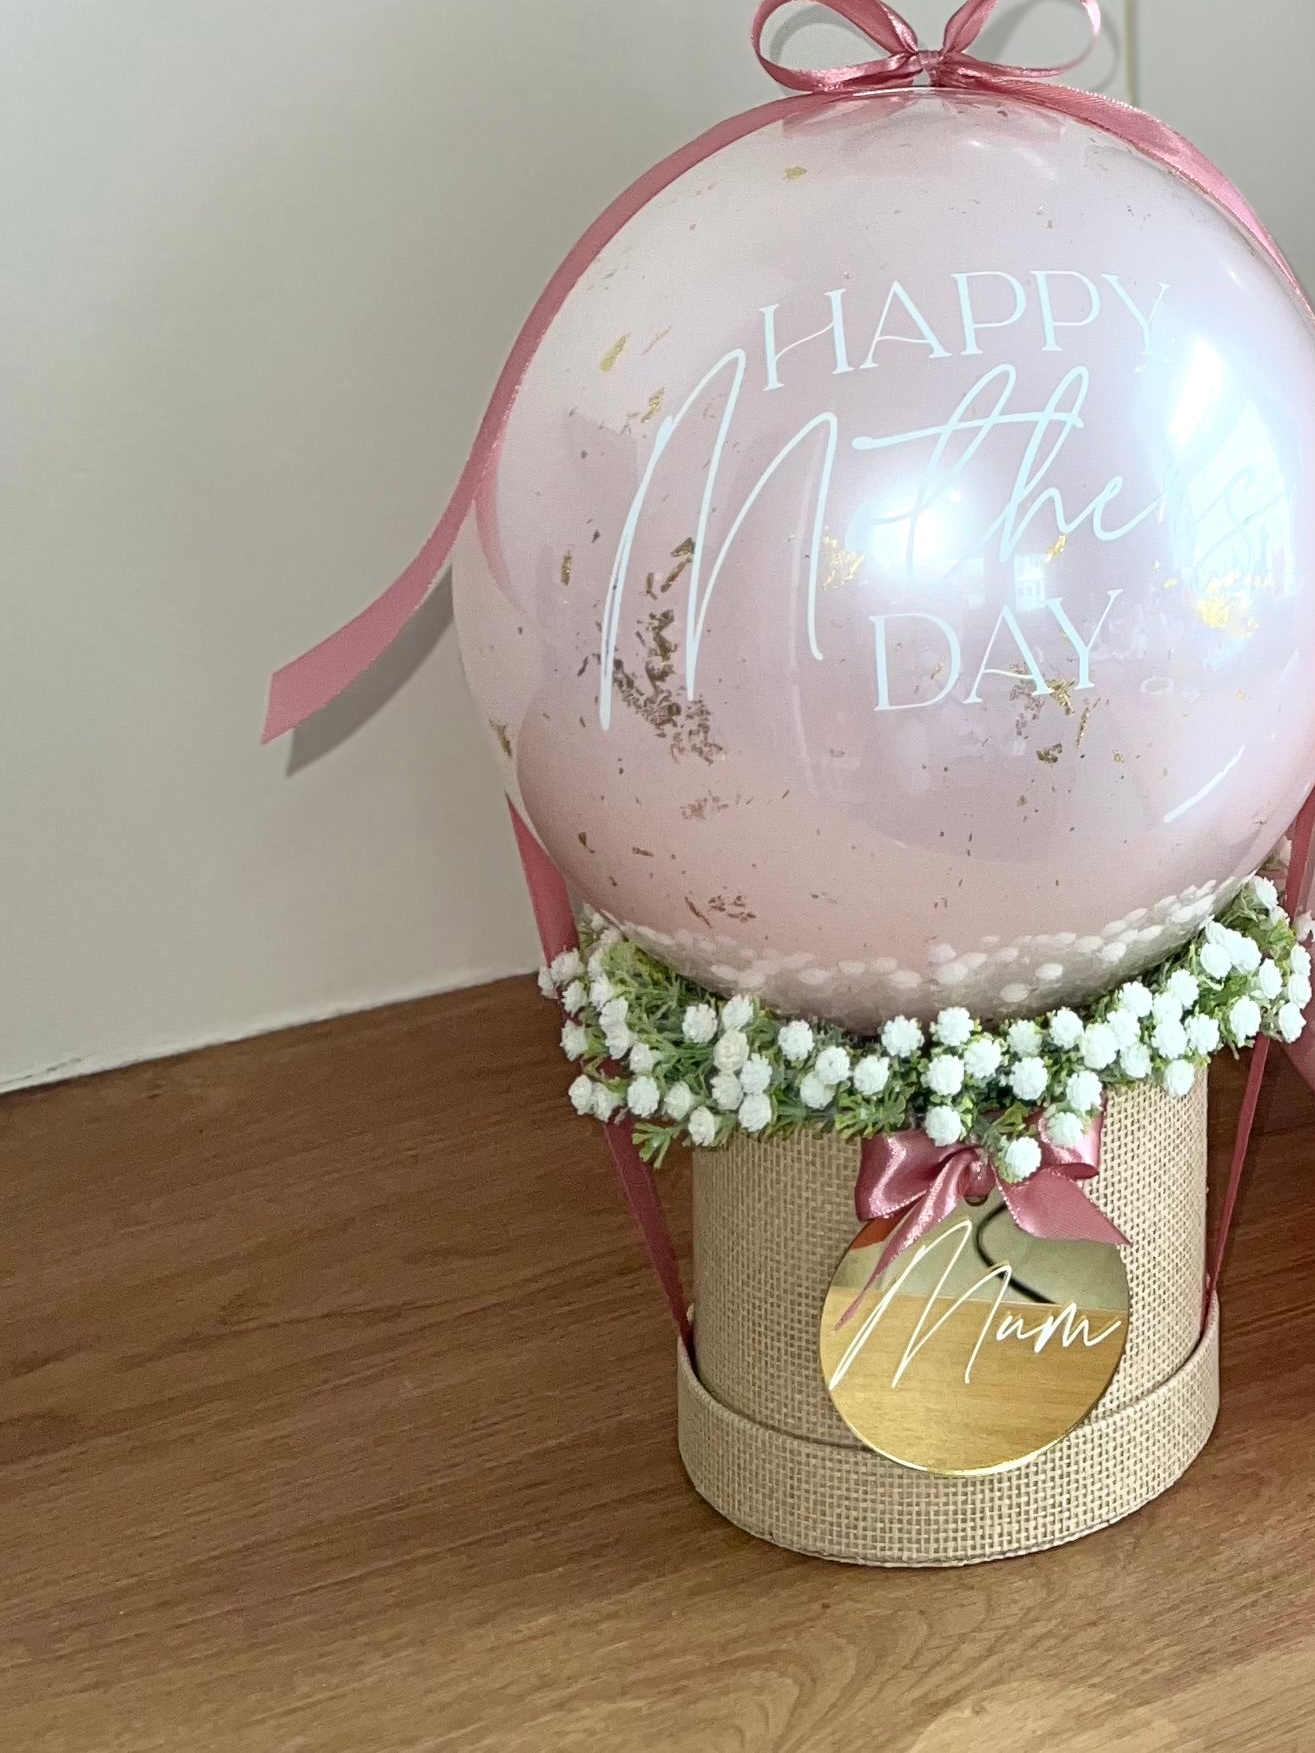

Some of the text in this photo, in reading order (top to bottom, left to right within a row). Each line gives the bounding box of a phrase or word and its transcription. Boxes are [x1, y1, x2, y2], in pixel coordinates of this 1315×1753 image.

[758, 269, 1172, 392] HAPPY
[868, 588, 1122, 711] DAY
[828, 1218, 1122, 1391] Mum
